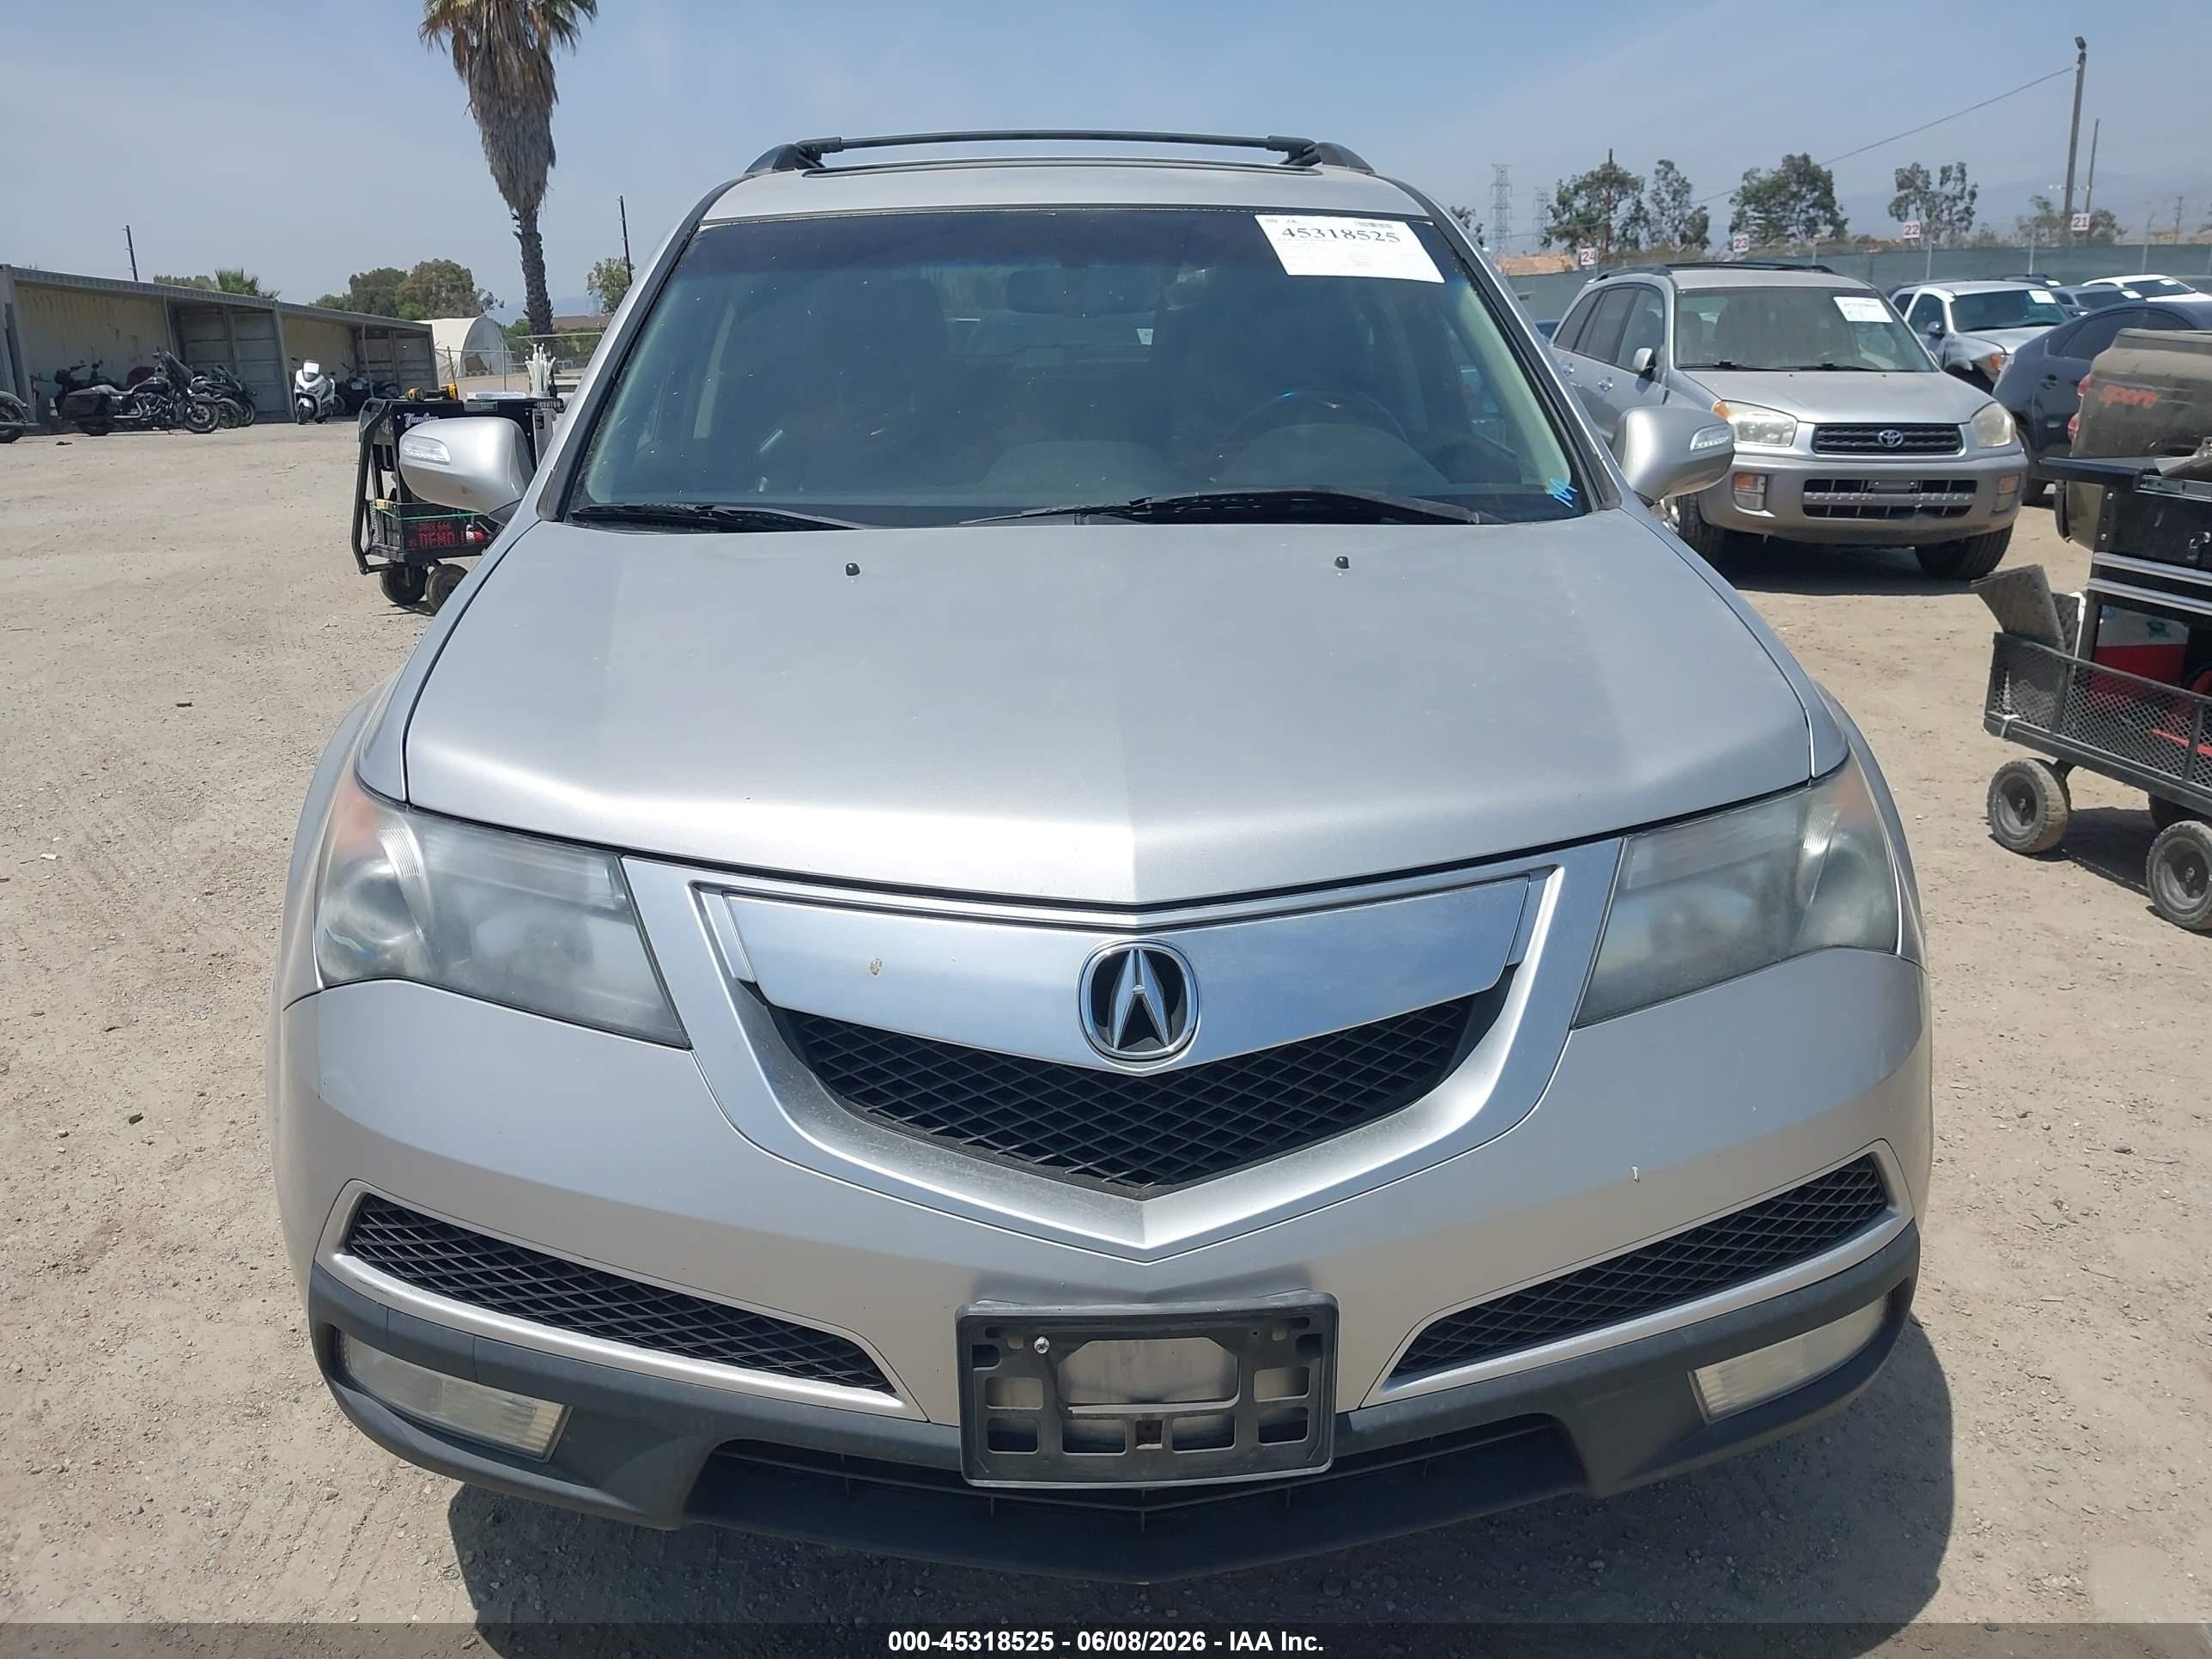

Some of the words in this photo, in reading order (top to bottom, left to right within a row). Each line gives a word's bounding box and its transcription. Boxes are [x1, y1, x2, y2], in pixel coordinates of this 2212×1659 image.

[2073, 216, 2088, 228] 21
[1281, 227, 1401, 243] 45318525
[1904, 224, 1919, 235] 22
[1734, 237, 1749, 249] 23
